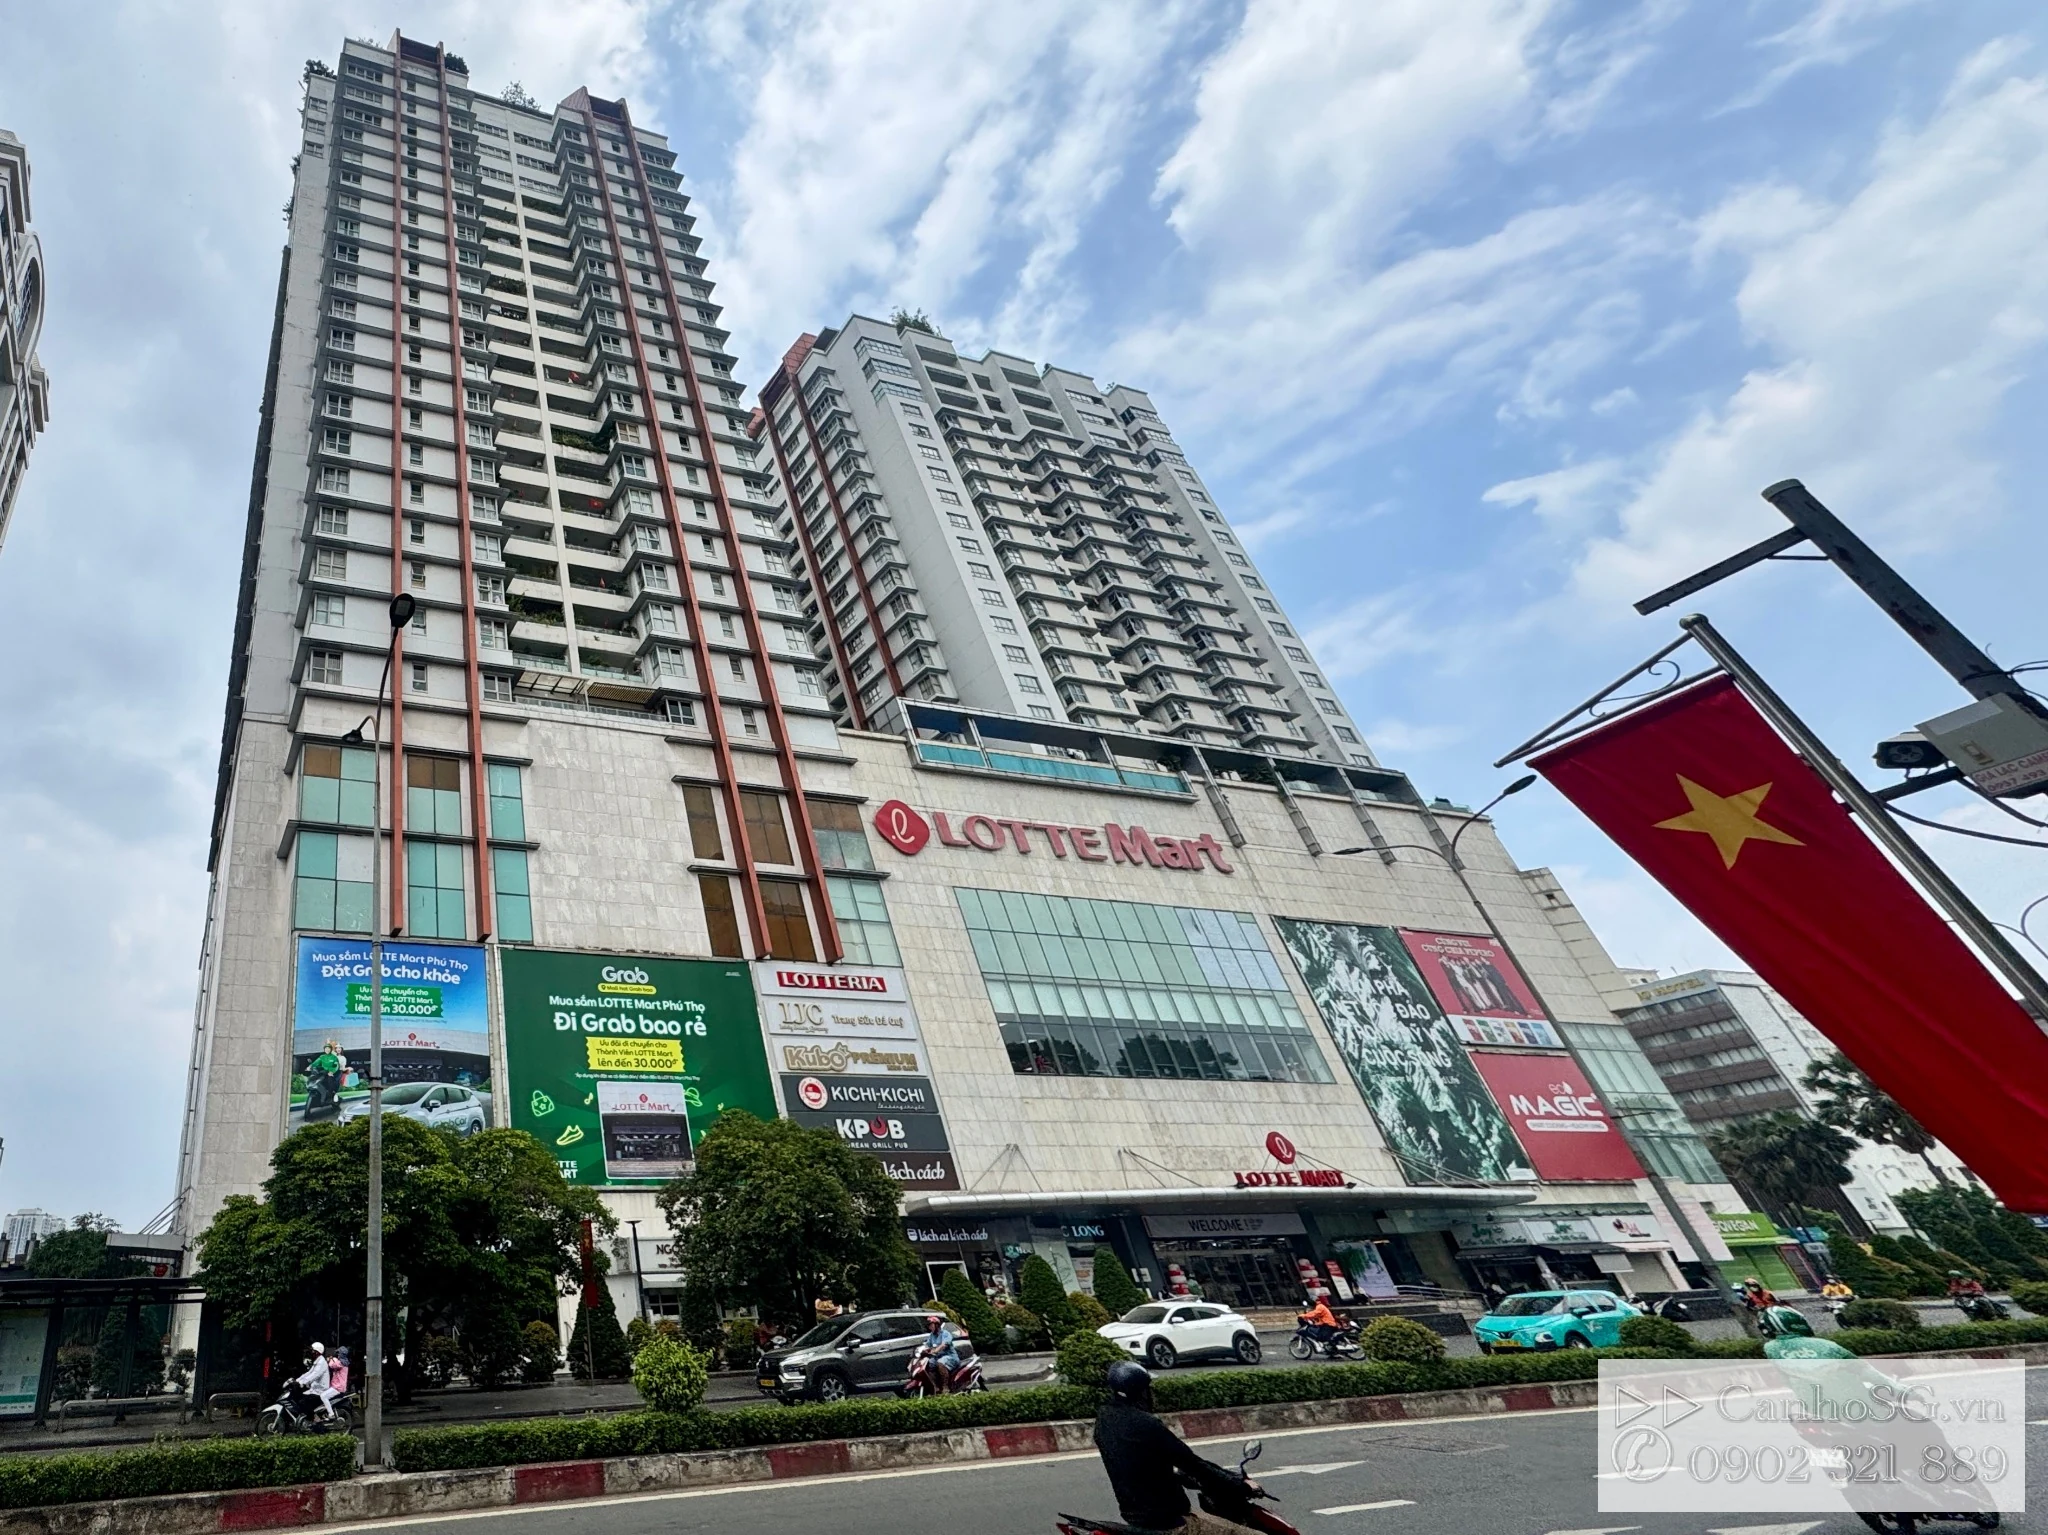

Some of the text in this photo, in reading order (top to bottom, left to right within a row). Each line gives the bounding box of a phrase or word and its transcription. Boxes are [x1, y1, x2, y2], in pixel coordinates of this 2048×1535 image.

[932, 811, 1235, 874] LOTTE Mart
[312, 950, 469, 973] Mua sắm LTTE Mart Phú Thọ
[321, 964, 461, 985] Đặt Grb cho khỏe
[602, 966, 649, 984] Grab
[781, 972, 884, 991] LOTTERIA
[354, 994, 373, 1002] Thàn
[393, 996, 416, 1004] LOTTE
[549, 994, 706, 1014] Mua sắm LOTTE Mart Phú Thọ
[354, 1003, 371, 1012] lên
[380, 1003, 391, 1013] ến
[553, 1012, 707, 1037] Đi Grab bao rẻ
[831, 1014, 857, 1027] Trang
[596, 1048, 618, 1056] Thành
[618, 1048, 634, 1056] Viên
[784, 1043, 917, 1071] Kubo PREMIUM
[598, 1058, 613, 1067] lên
[614, 1057, 633, 1068] đến
[830, 1085, 925, 1103] KICHI-KICHI
[614, 1102, 671, 1111] LOTTE Mart
[836, 1116, 906, 1139] KPUB
[557, 1160, 578, 1168] TTE
[1234, 1170, 1345, 1187] LOTTE MART
[1071, 1225, 1105, 1237] LONG
[1188, 1219, 1244, 1231] WELCOME
